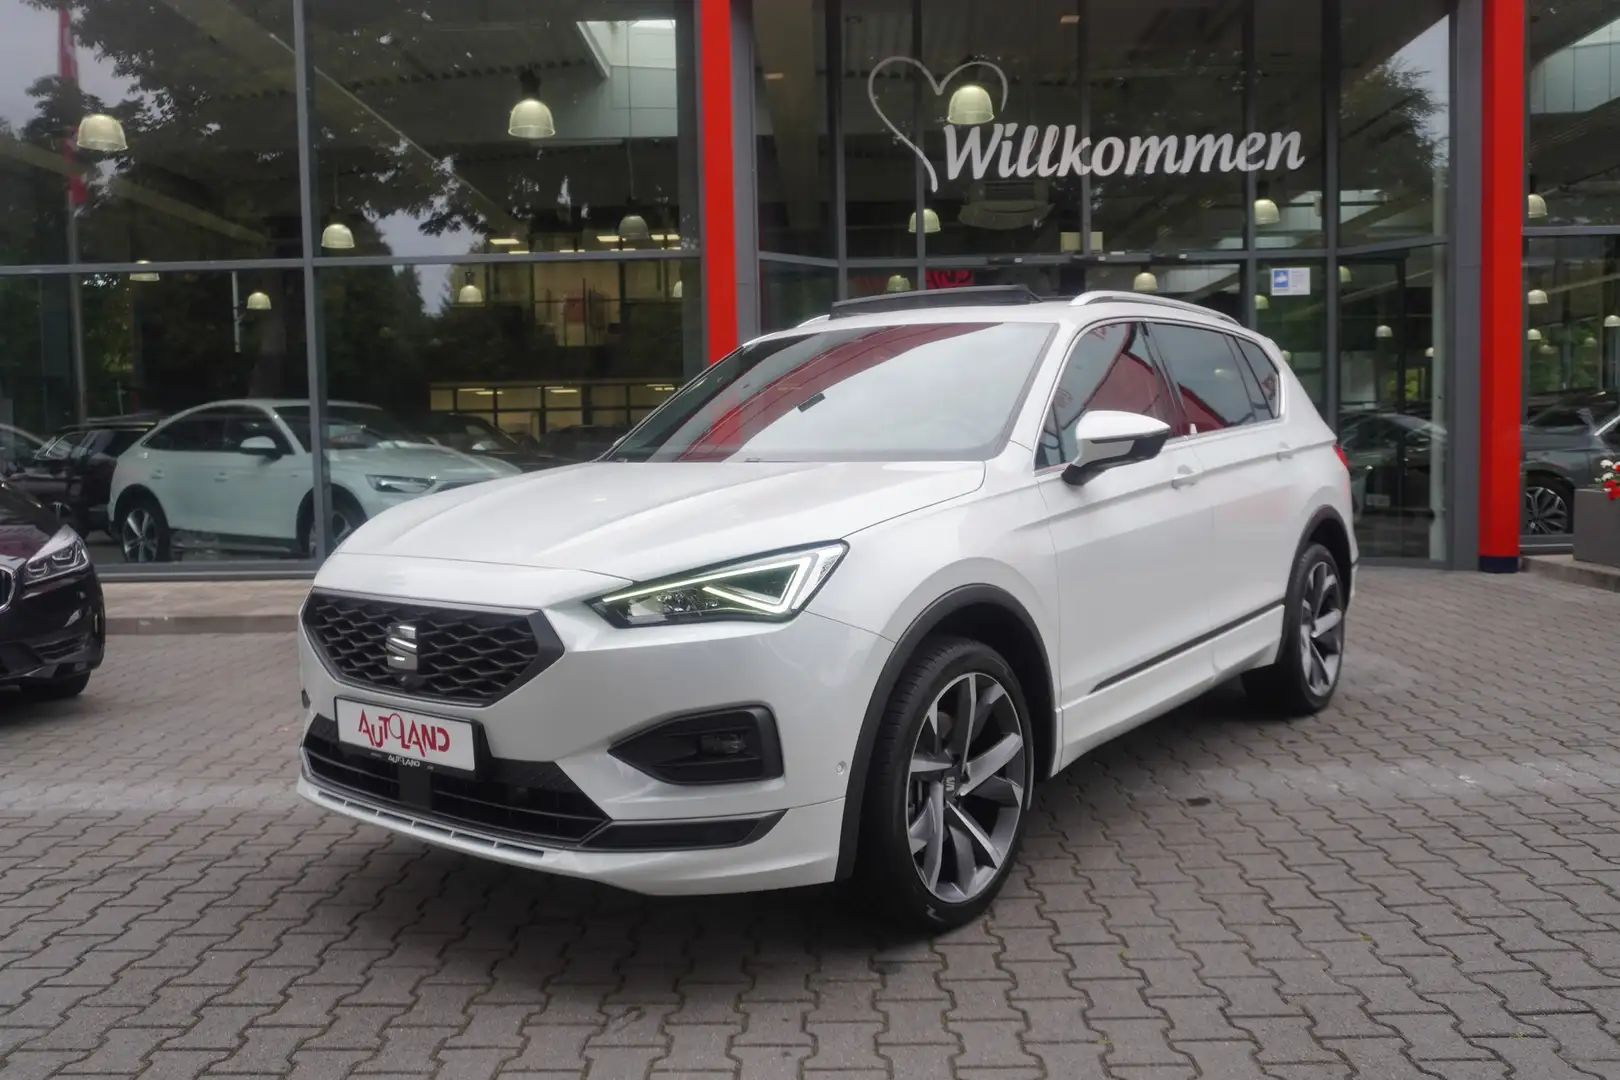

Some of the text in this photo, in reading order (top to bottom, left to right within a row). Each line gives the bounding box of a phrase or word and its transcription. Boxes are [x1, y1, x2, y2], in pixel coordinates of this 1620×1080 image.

[943, 122, 1305, 180] Willkommen
[358, 709, 450, 757] AUTOLAND
[388, 754, 421, 768] AUTLAND
